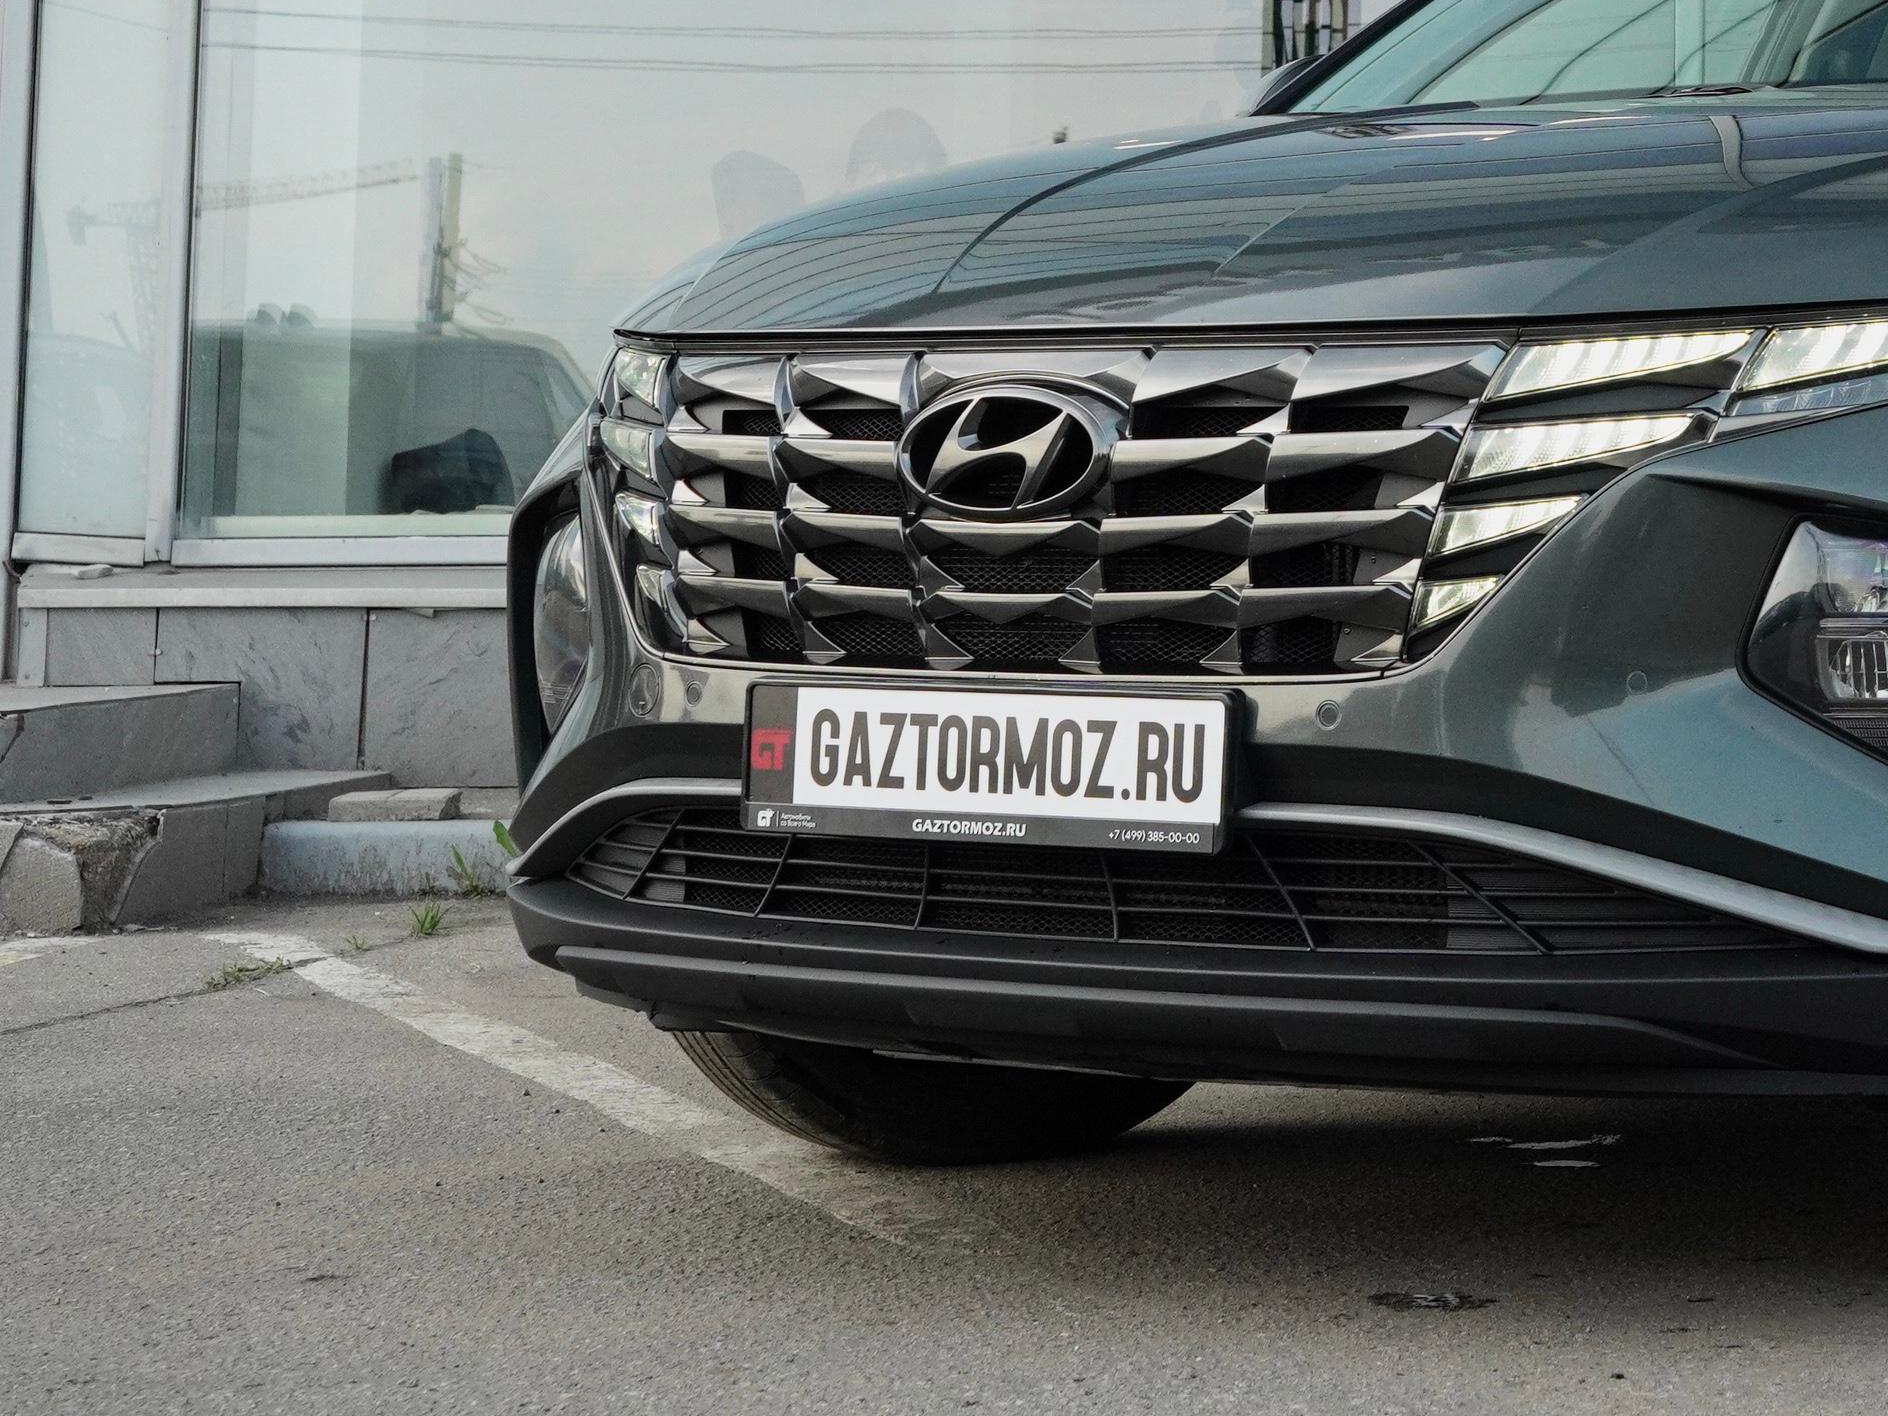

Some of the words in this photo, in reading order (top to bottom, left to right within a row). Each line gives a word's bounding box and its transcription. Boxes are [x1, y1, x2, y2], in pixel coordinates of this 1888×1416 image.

[810, 708, 1206, 804] GAZTORMOZ.RU
[912, 818, 1026, 837] GAZTORMOZ.RU
[1108, 829, 1121, 840] +7
[1121, 829, 1146, 842] (499)
[1147, 830, 1200, 844] 385-00-00
